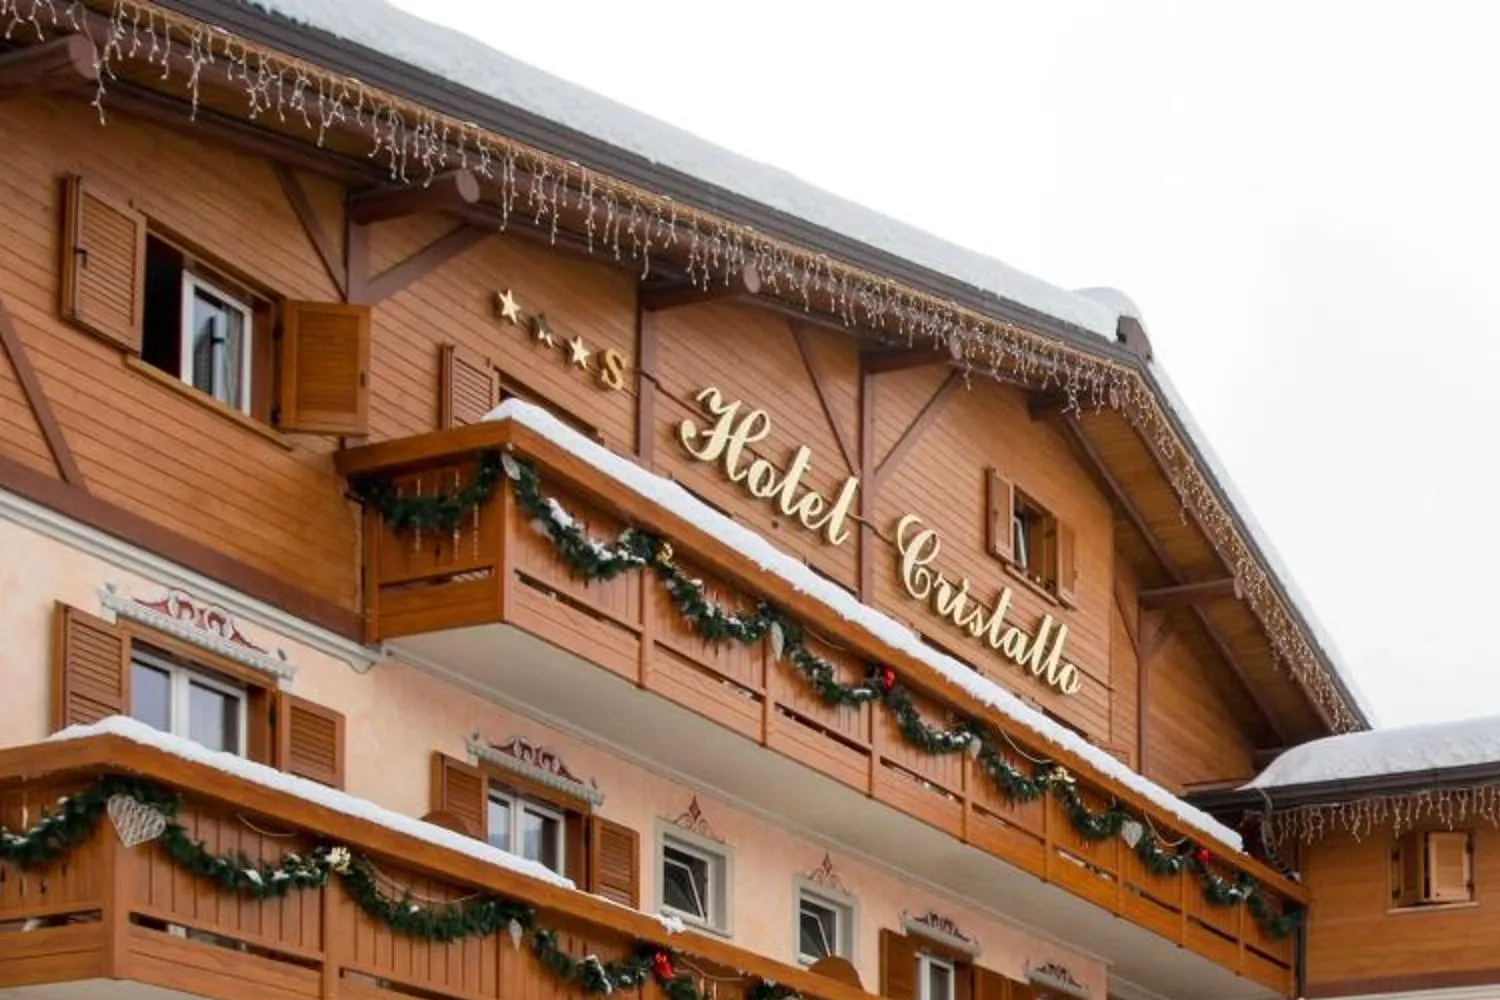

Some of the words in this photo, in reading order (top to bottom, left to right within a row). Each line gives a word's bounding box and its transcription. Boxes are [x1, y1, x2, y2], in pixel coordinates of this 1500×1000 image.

[601, 347, 627, 391] S
[680, 386, 860, 545] Hotel
[897, 513, 1082, 695] Cristallo
